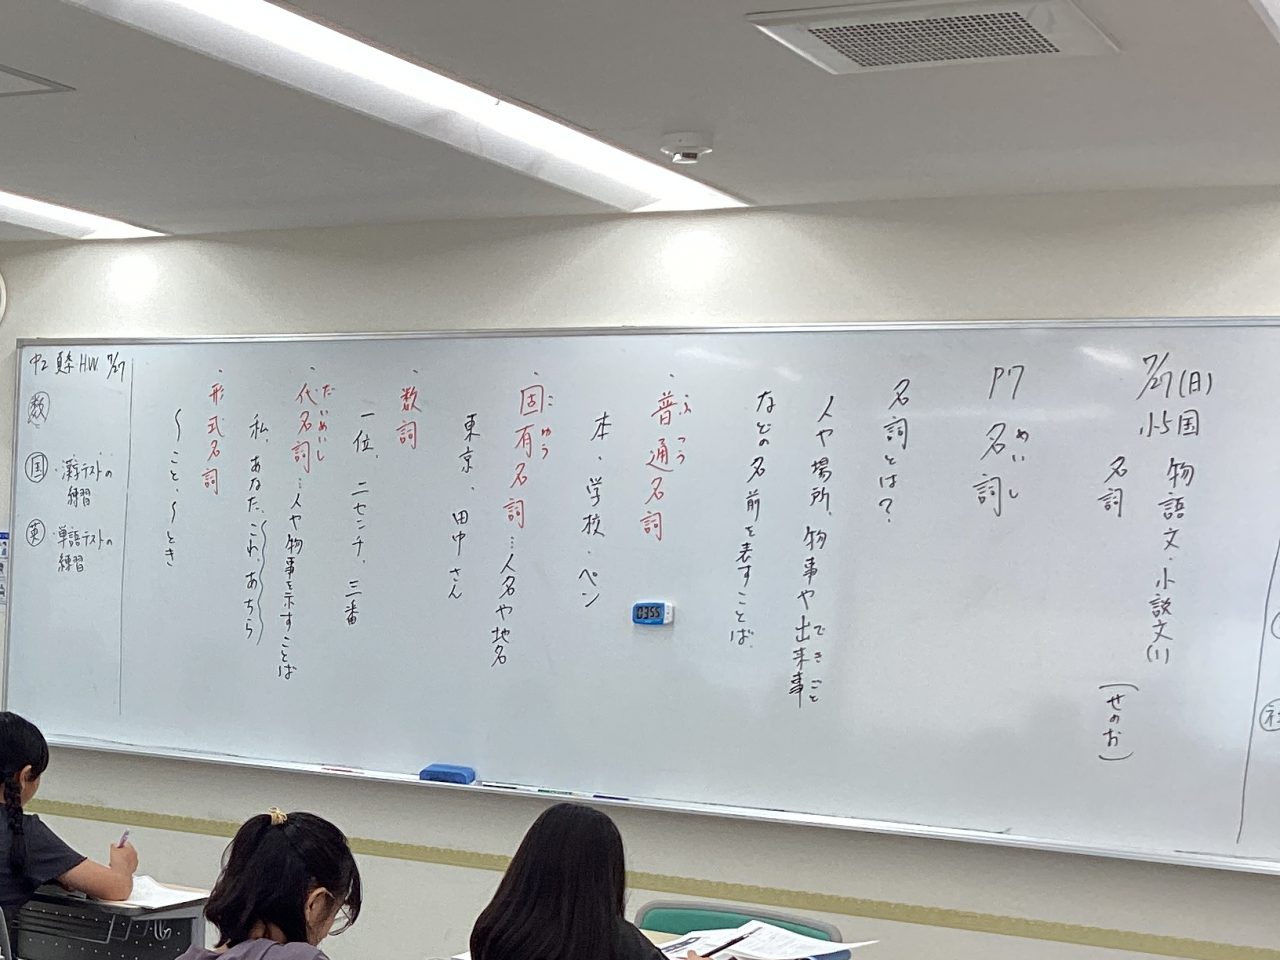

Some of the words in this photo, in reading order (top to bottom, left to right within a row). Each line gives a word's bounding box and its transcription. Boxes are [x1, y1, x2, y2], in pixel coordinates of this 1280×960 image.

[30, 353, 48, 375] 中2
[80, 353, 99, 373] HW
[973, 423, 1006, 517] 名詞
[1097, 456, 1128, 517] 名詞
